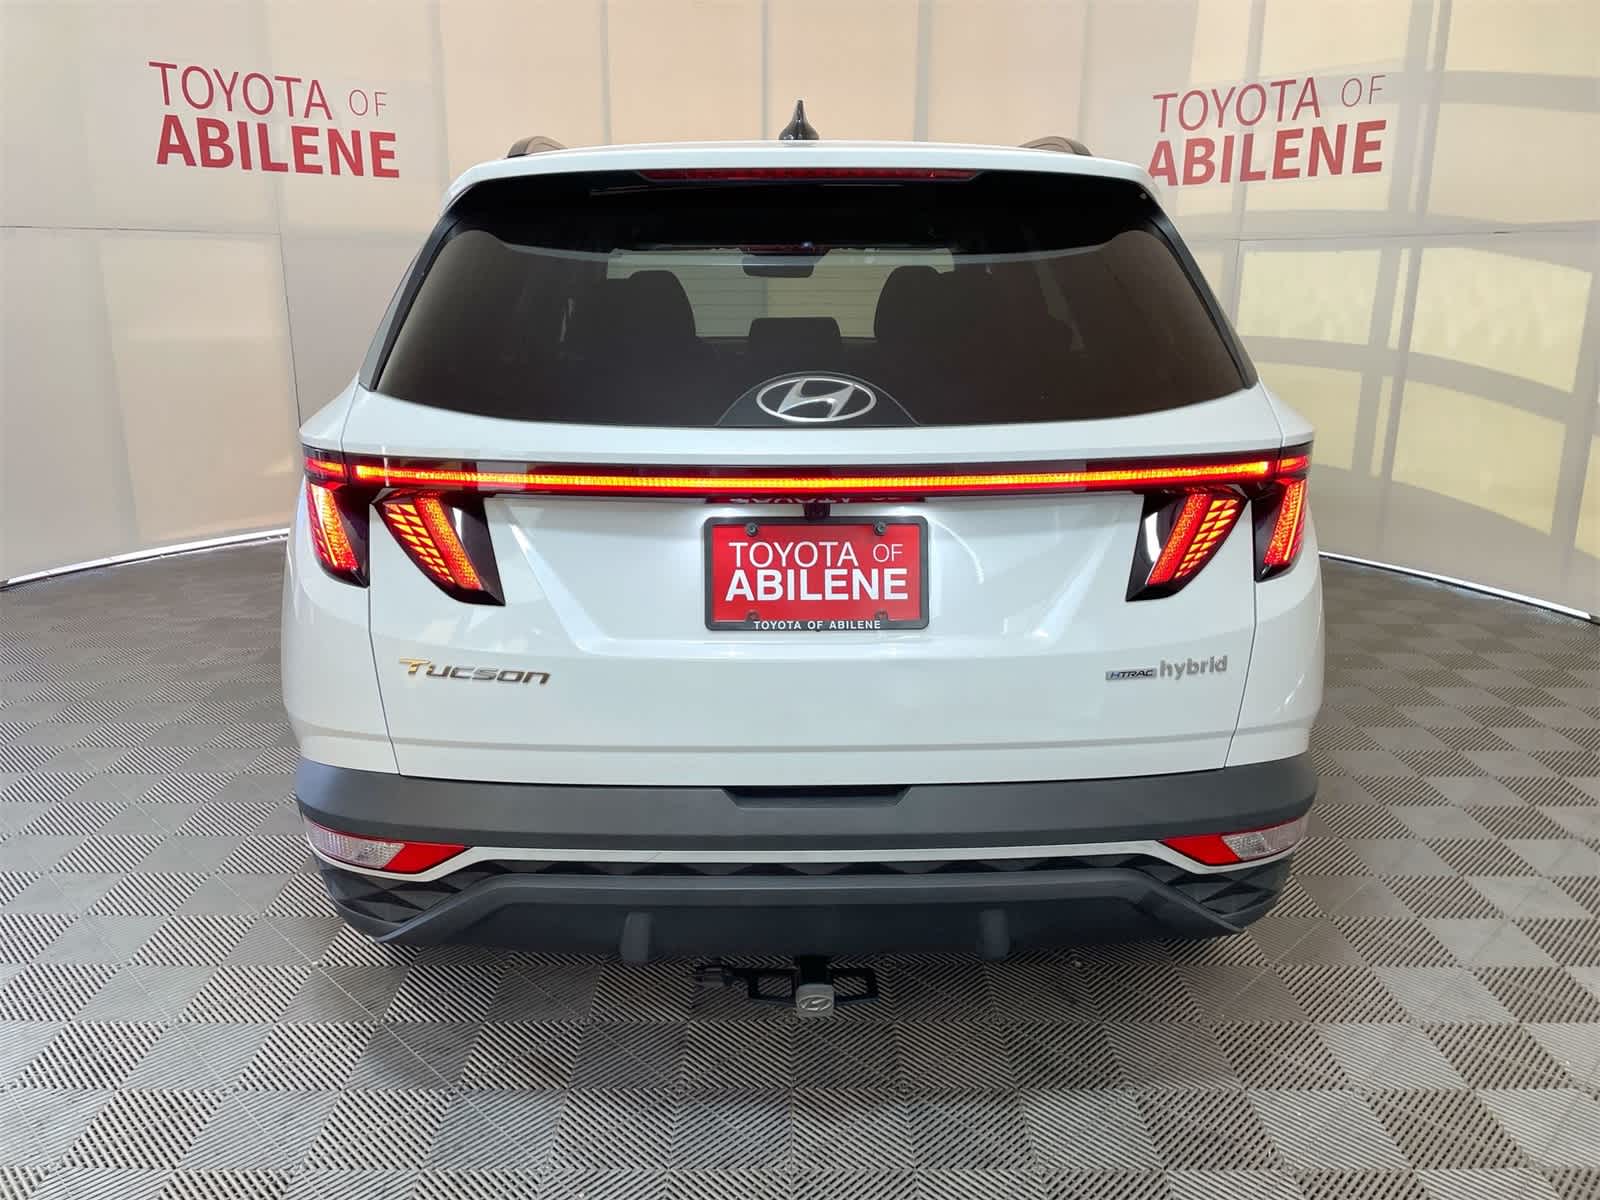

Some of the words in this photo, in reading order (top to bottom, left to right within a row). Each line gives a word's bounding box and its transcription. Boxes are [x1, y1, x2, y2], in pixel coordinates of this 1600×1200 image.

[148, 61, 333, 121] TOYOTA
[348, 88, 388, 118] OF
[1152, 76, 1321, 133] TOYOTA
[1341, 74, 1386, 108] OF
[156, 114, 401, 178] ABILENE
[1147, 119, 1388, 187] ABILENE
[728, 541, 860, 568] TOYOTA
[872, 543, 904, 563] OF
[725, 567, 909, 602] ABILENE
[753, 620, 802, 631] TOYOTA
[807, 619, 824, 630] OF
[828, 619, 881, 630] ABILENE
[1109, 669, 1155, 680] HTRAC
[1159, 655, 1229, 681] hybrid
